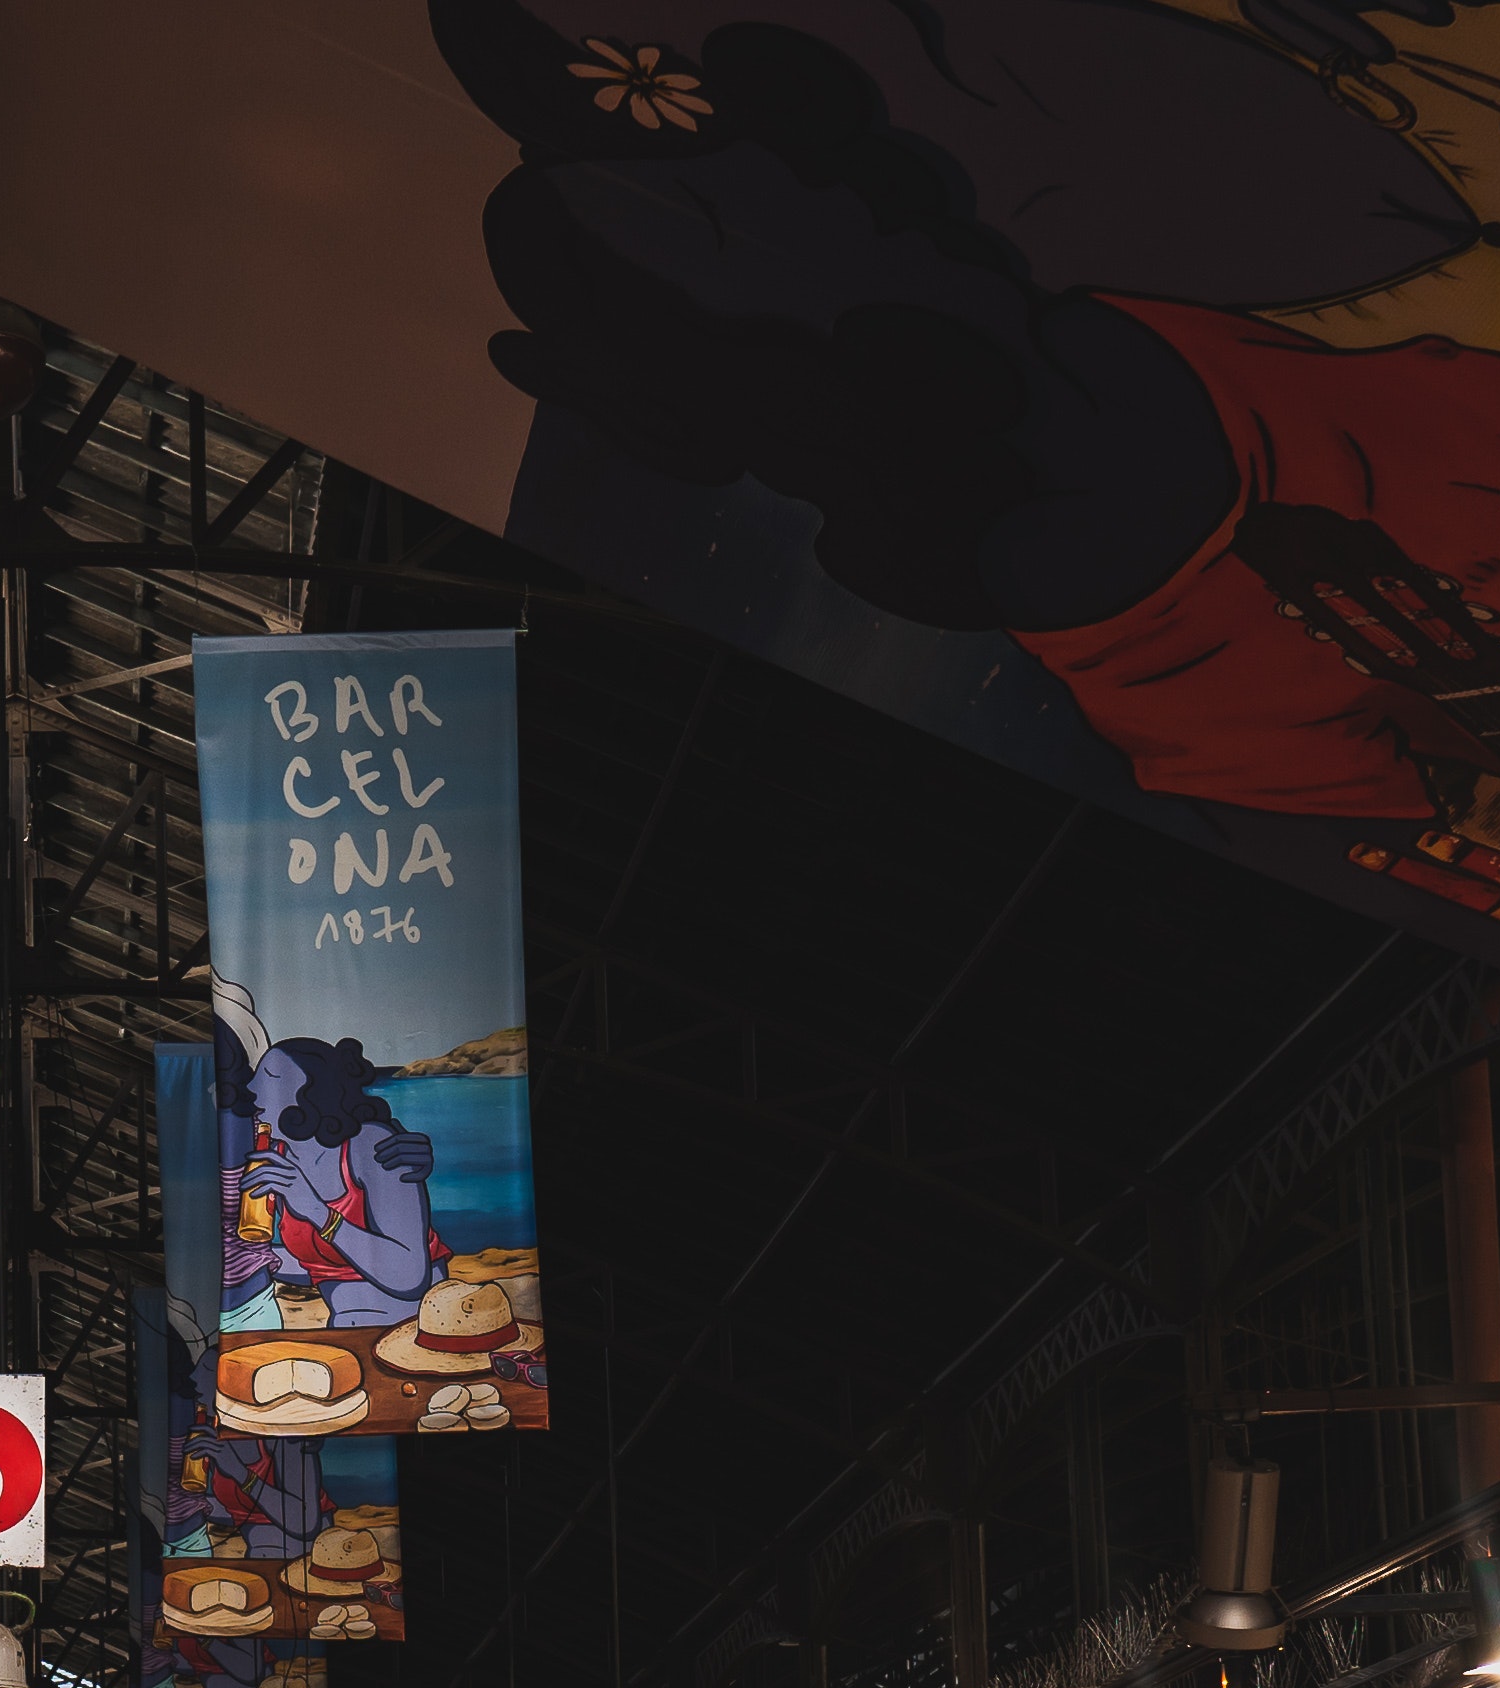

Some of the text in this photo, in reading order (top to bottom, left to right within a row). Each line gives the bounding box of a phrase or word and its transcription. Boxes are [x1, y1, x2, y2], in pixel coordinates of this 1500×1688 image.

[264, 674, 442, 742] BAR
[283, 748, 445, 818] CEL
[288, 824, 454, 895] ONA
[315, 906, 420, 950] 1876
